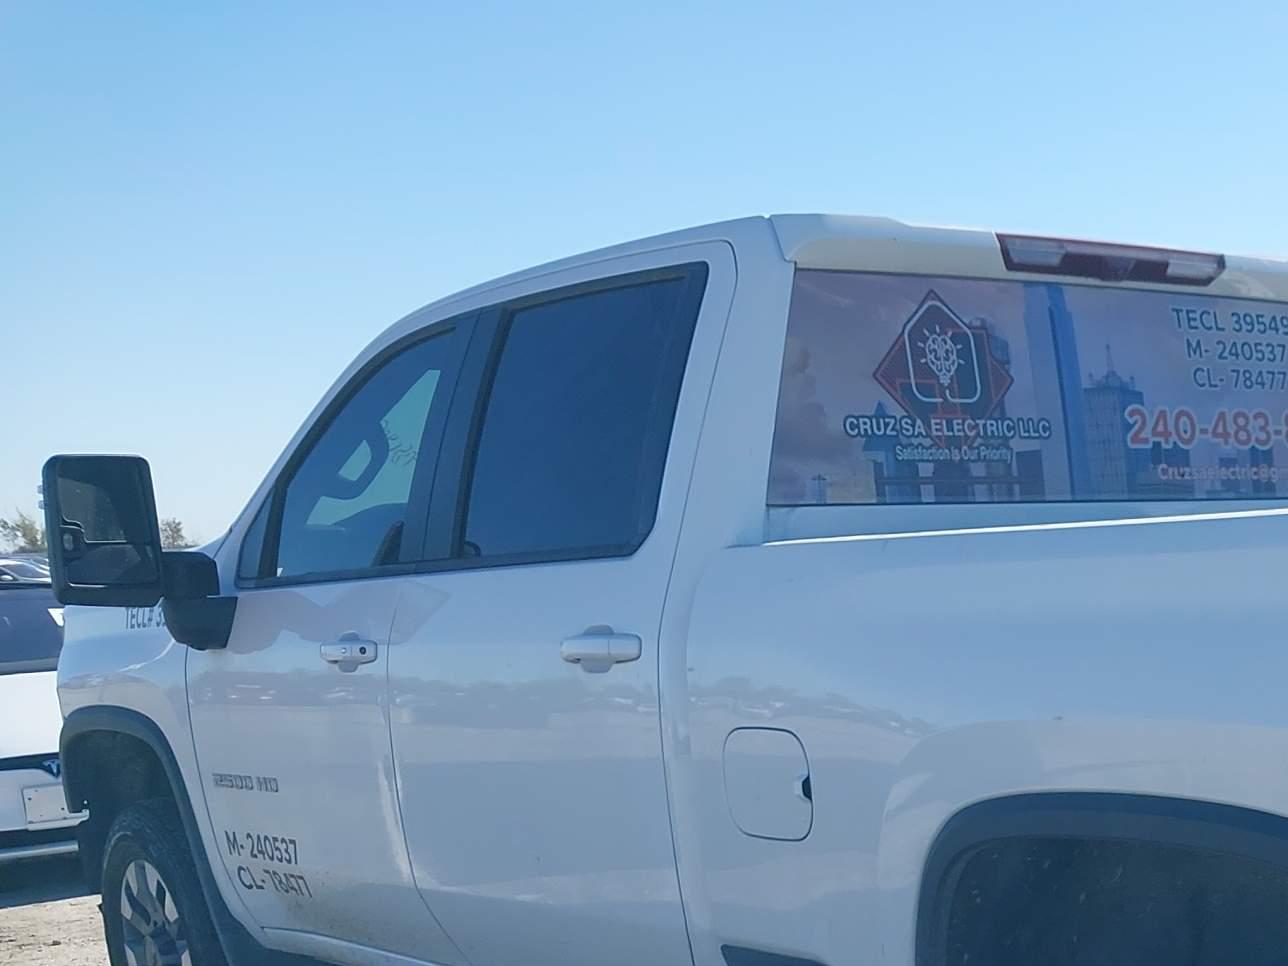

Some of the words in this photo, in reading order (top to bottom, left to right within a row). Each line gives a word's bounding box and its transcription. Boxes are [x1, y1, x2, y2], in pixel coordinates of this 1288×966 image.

[1170, 307, 1226, 332] TECL
[1215, 339, 1287, 362] 240537
[1192, 366, 1225, 389] CL-
[1229, 368, 1288, 391] 78477
[844, 416, 898, 437] CRUZ
[899, 417, 927, 437] SA
[929, 418, 1015, 438] ELECTRIC
[1017, 419, 1051, 439] LLC
[895, 445, 950, 461] Satisfaction
